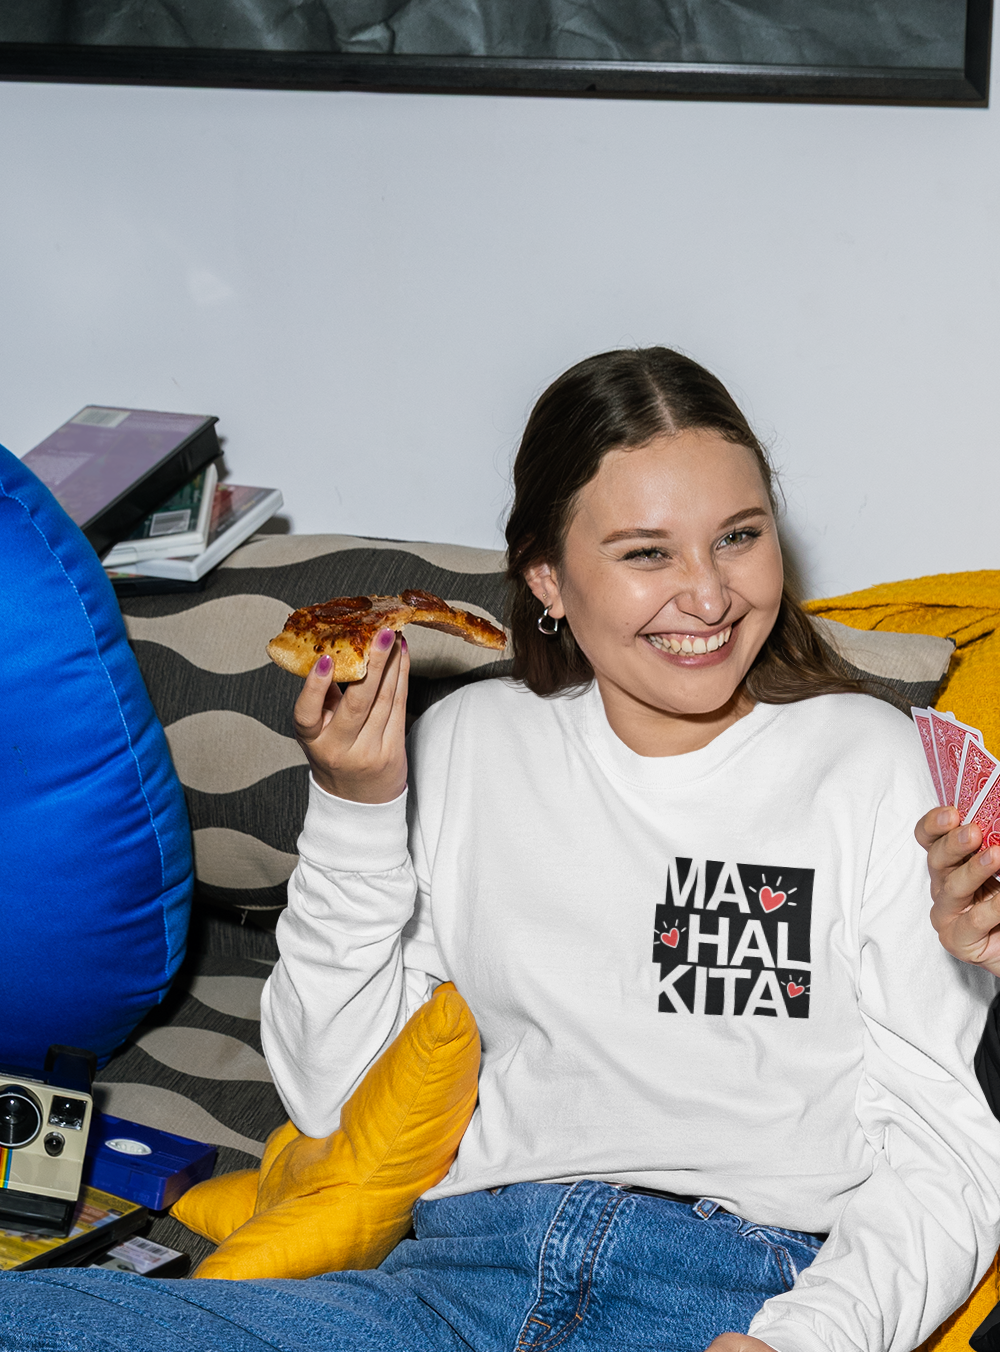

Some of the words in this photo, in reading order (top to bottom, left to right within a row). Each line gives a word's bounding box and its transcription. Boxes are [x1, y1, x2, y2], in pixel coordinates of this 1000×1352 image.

[658, 856, 752, 914] MA
[687, 913, 812, 972] HAL
[650, 963, 791, 1018] KITA
